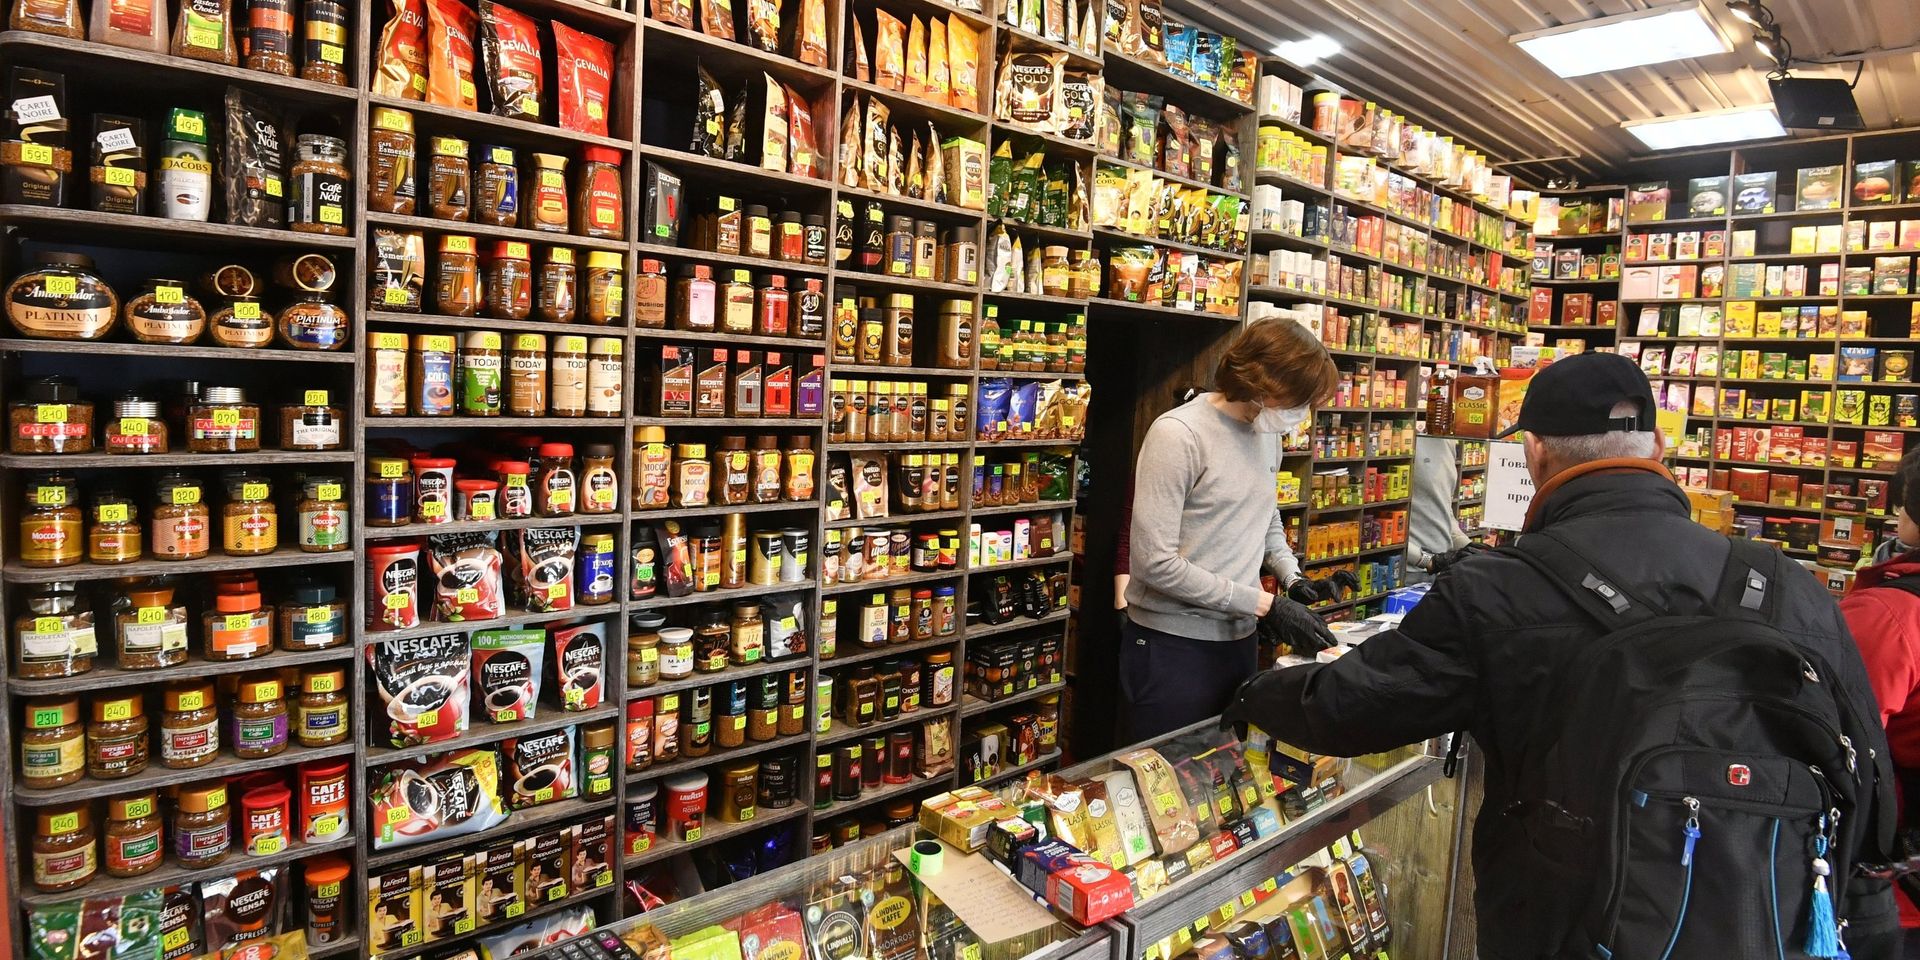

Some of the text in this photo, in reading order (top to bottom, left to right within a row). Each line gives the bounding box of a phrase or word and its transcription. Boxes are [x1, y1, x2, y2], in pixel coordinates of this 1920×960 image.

[324, 46, 340, 60] 285
[500, 40, 540, 59] GEVALIA
[575, 58, 608, 80] GEVALIA
[1014, 74, 1048, 83] GOLD
[19, 101, 51, 112] CARTE
[22, 107, 54, 119] NOIRE
[256, 121, 277, 138] Café
[102, 132, 127, 143] CARTE
[258, 133, 279, 150] Noir
[105, 138, 130, 149] NOIRE
[27, 150, 49, 162] 595
[168, 161, 208, 172] JACOBS
[110, 171, 132, 183] 320
[22, 182, 50, 191] Original
[319, 182, 342, 194] Café
[319, 191, 342, 203] Noir
[593, 191, 617, 199] GEVALIA
[105, 196, 134, 205] Original
[450, 241, 467, 249] 430
[50, 281, 71, 291] 320
[388, 292, 406, 302] 550
[25, 310, 98, 322] PLATINUM
[296, 315, 341, 325] PLATINUM
[144, 322, 193, 330] PLATINUM
[224, 329, 264, 337] PLATINUM
[383, 337, 399, 346] 330
[432, 339, 447, 348] 340
[521, 340, 537, 348] 240
[473, 358, 500, 367] TODAY
[307, 394, 325, 404] 220
[671, 392, 685, 400] VS
[41, 409, 63, 420] 210
[216, 413, 236, 424] 270
[21, 423, 48, 435] CAFÉ
[123, 422, 143, 432] 140
[384, 465, 400, 475] 325
[177, 490, 195, 501] 320
[321, 487, 339, 498] 320
[106, 509, 120, 520] 95
[477, 506, 486, 514] 80
[242, 521, 271, 530] MOCCONA
[313, 517, 339, 526] MOCCONA
[174, 524, 203, 533] MOCCONA
[32, 531, 65, 541] MOCCONA
[459, 592, 476, 602] 250
[142, 610, 161, 621] 210
[39, 622, 58, 632] 210
[478, 635, 492, 645] 100
[314, 680, 331, 690] 260
[258, 687, 276, 697] 260
[181, 697, 200, 706] 240
[107, 706, 125, 717] 240
[37, 713, 57, 725] 230
[420, 715, 436, 725] 420
[105, 761, 127, 769] ROM
[311, 780, 345, 796] CAFÉ
[208, 794, 225, 806] 250
[680, 792, 704, 801] LAVAZZA
[128, 804, 149, 816] 280
[391, 811, 406, 819] 680
[53, 816, 74, 829] 240
[319, 823, 336, 833] 270
[578, 833, 607, 844] Cappuccino
[687, 831, 700, 840] 330
[531, 847, 562, 858] Cappuccino
[483, 861, 516, 872] Cappuccino
[432, 875, 466, 887] Cappuccino
[598, 874, 609, 883] 80
[321, 886, 339, 896] 260
[378, 886, 412, 899] Cappuccino
[552, 888, 561, 897] 80
[237, 900, 266, 913] SENSA
[509, 906, 519, 915] 80
[882, 911, 902, 925] KAFFE
[458, 921, 469, 931] 80
[235, 927, 268, 941] ESPRESSO
[407, 932, 418, 943] 80
